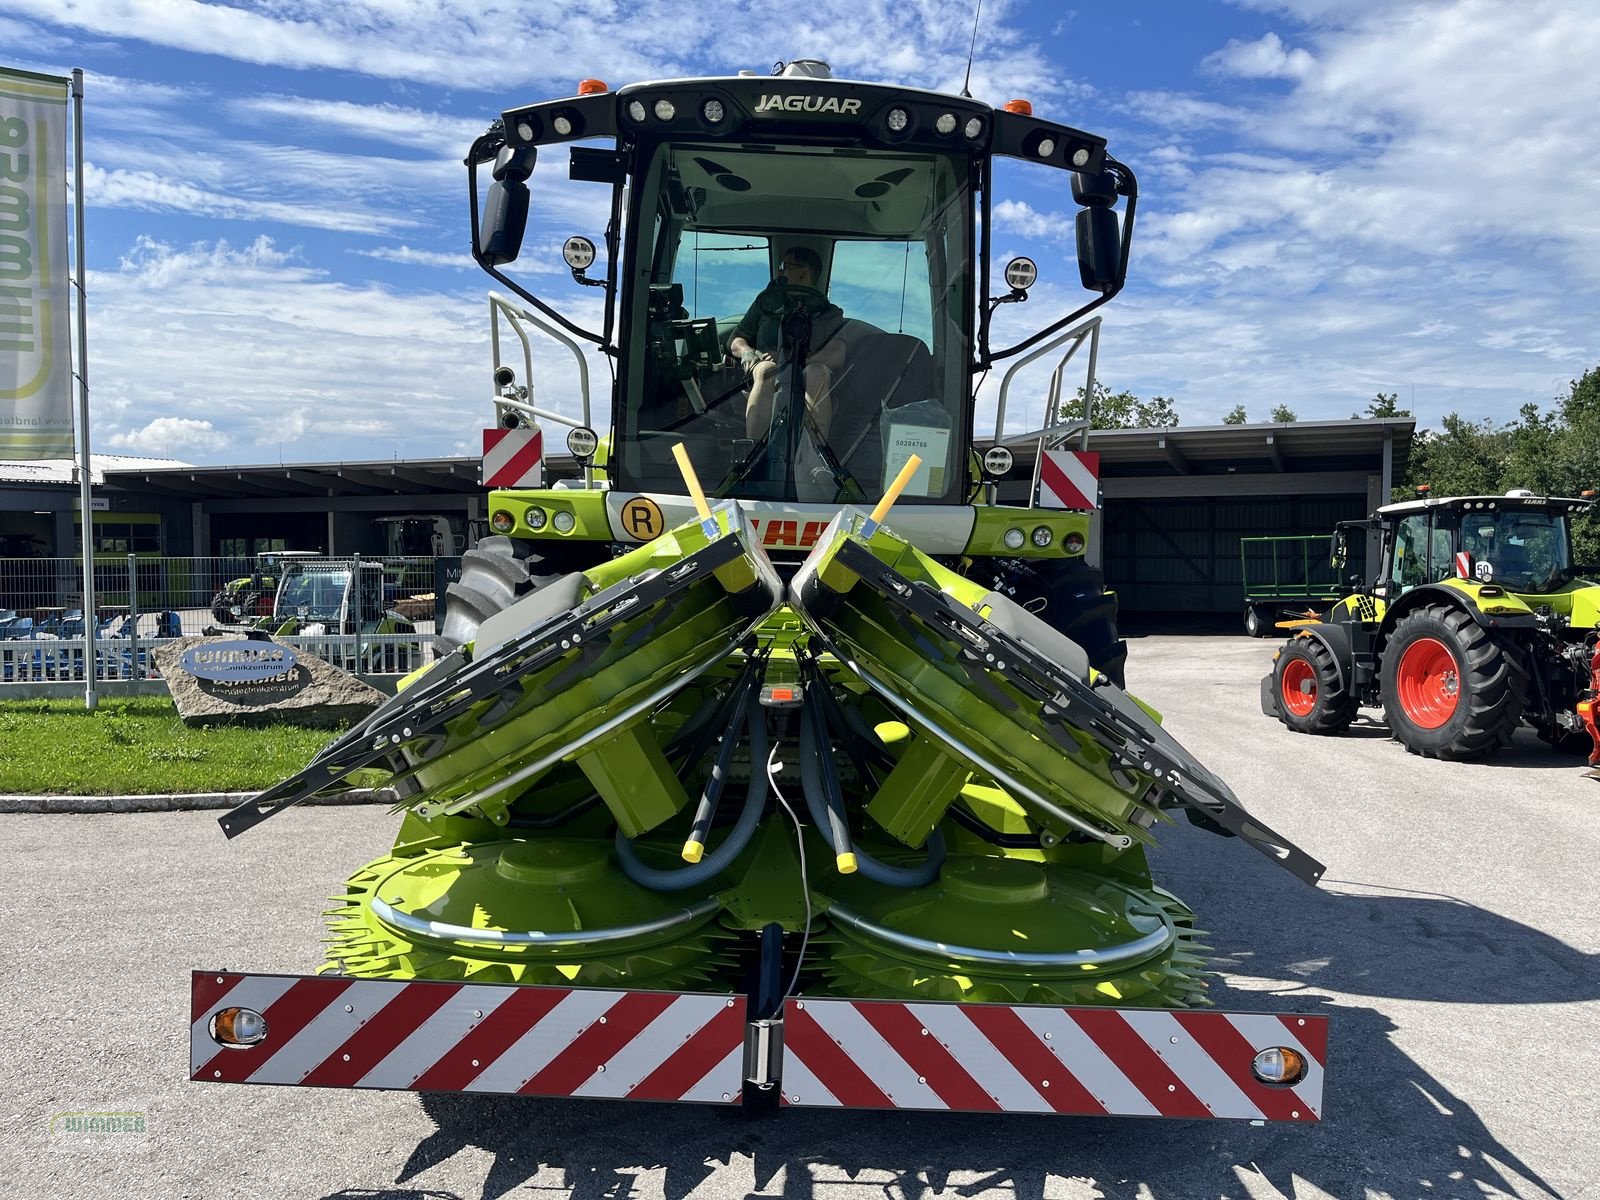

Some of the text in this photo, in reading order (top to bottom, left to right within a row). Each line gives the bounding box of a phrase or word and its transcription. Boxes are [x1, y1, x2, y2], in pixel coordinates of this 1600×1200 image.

[754, 95, 862, 115] JAGUAR
[631, 506, 654, 534] R
[1477, 564, 1489, 575] 50
